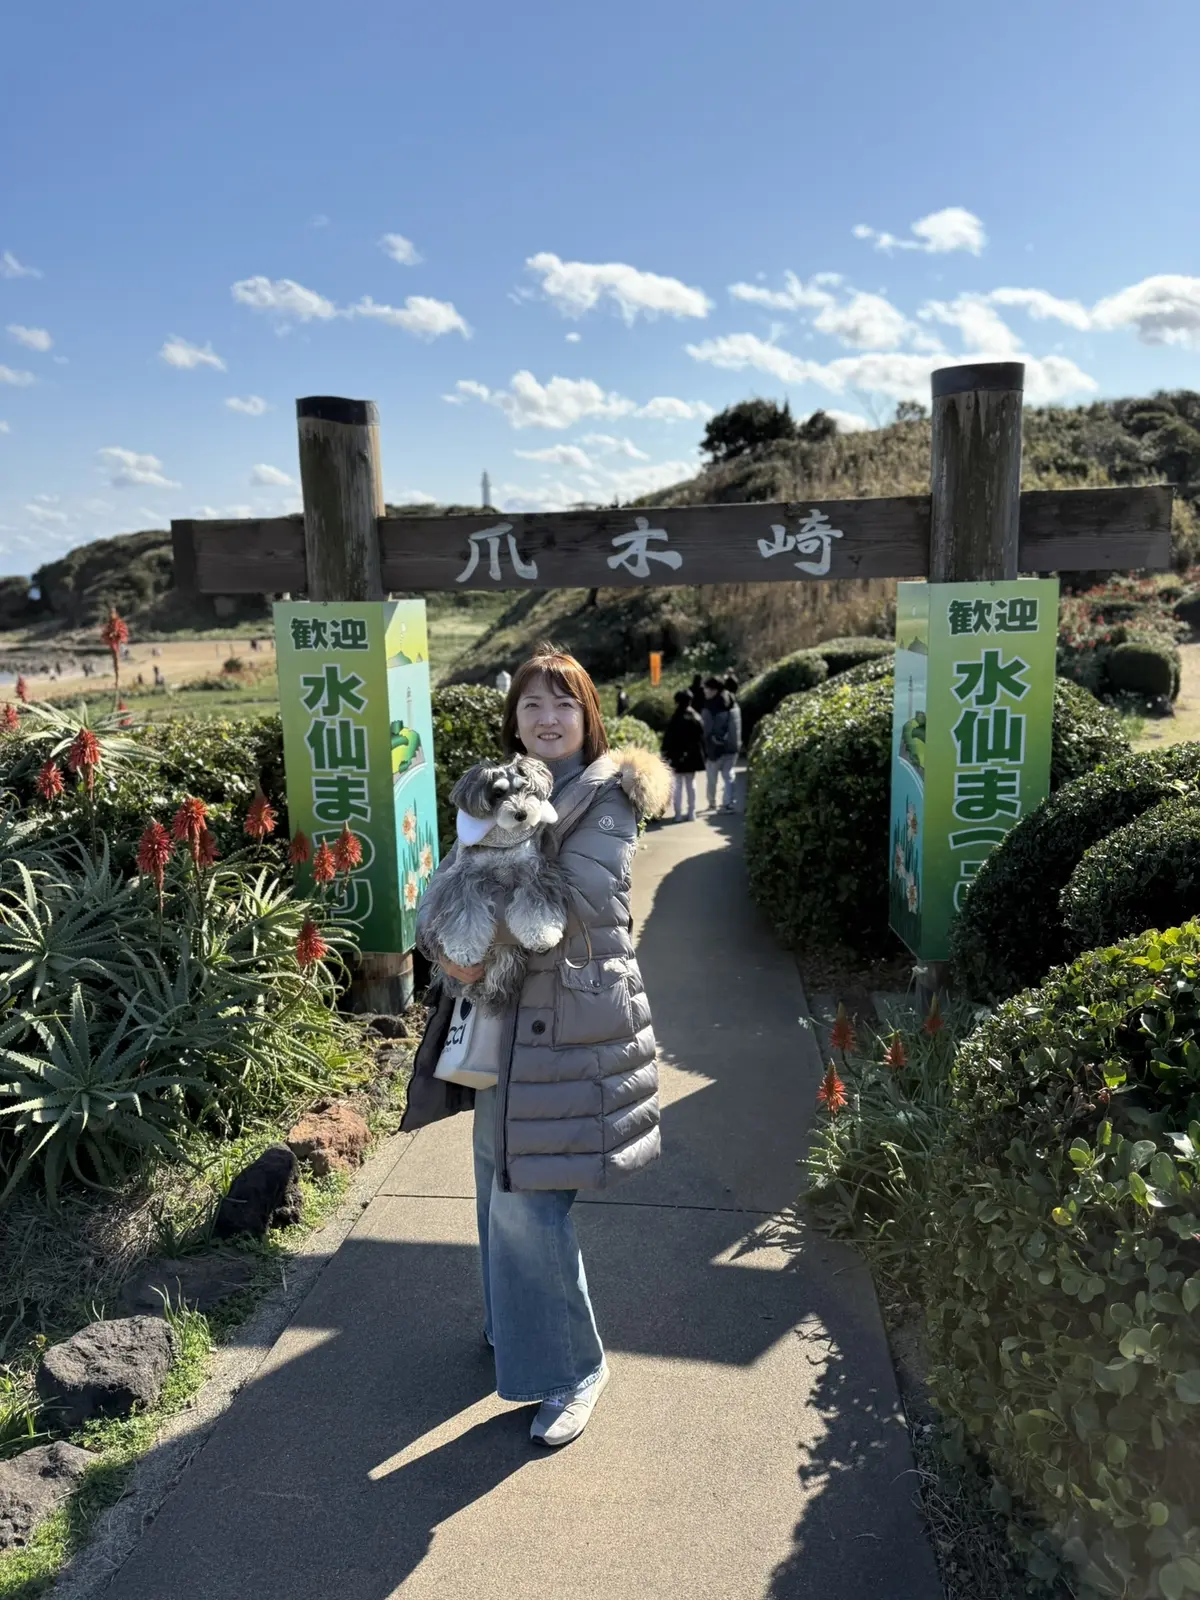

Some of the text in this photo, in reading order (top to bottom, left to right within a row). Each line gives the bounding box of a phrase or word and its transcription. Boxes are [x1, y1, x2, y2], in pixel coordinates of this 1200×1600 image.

[455, 509, 843, 583] 爪木崎
[291, 617, 368, 651] 歓迎
[948, 597, 1040, 635] 歓迎
[949, 648, 1031, 913] 水仙まつ
